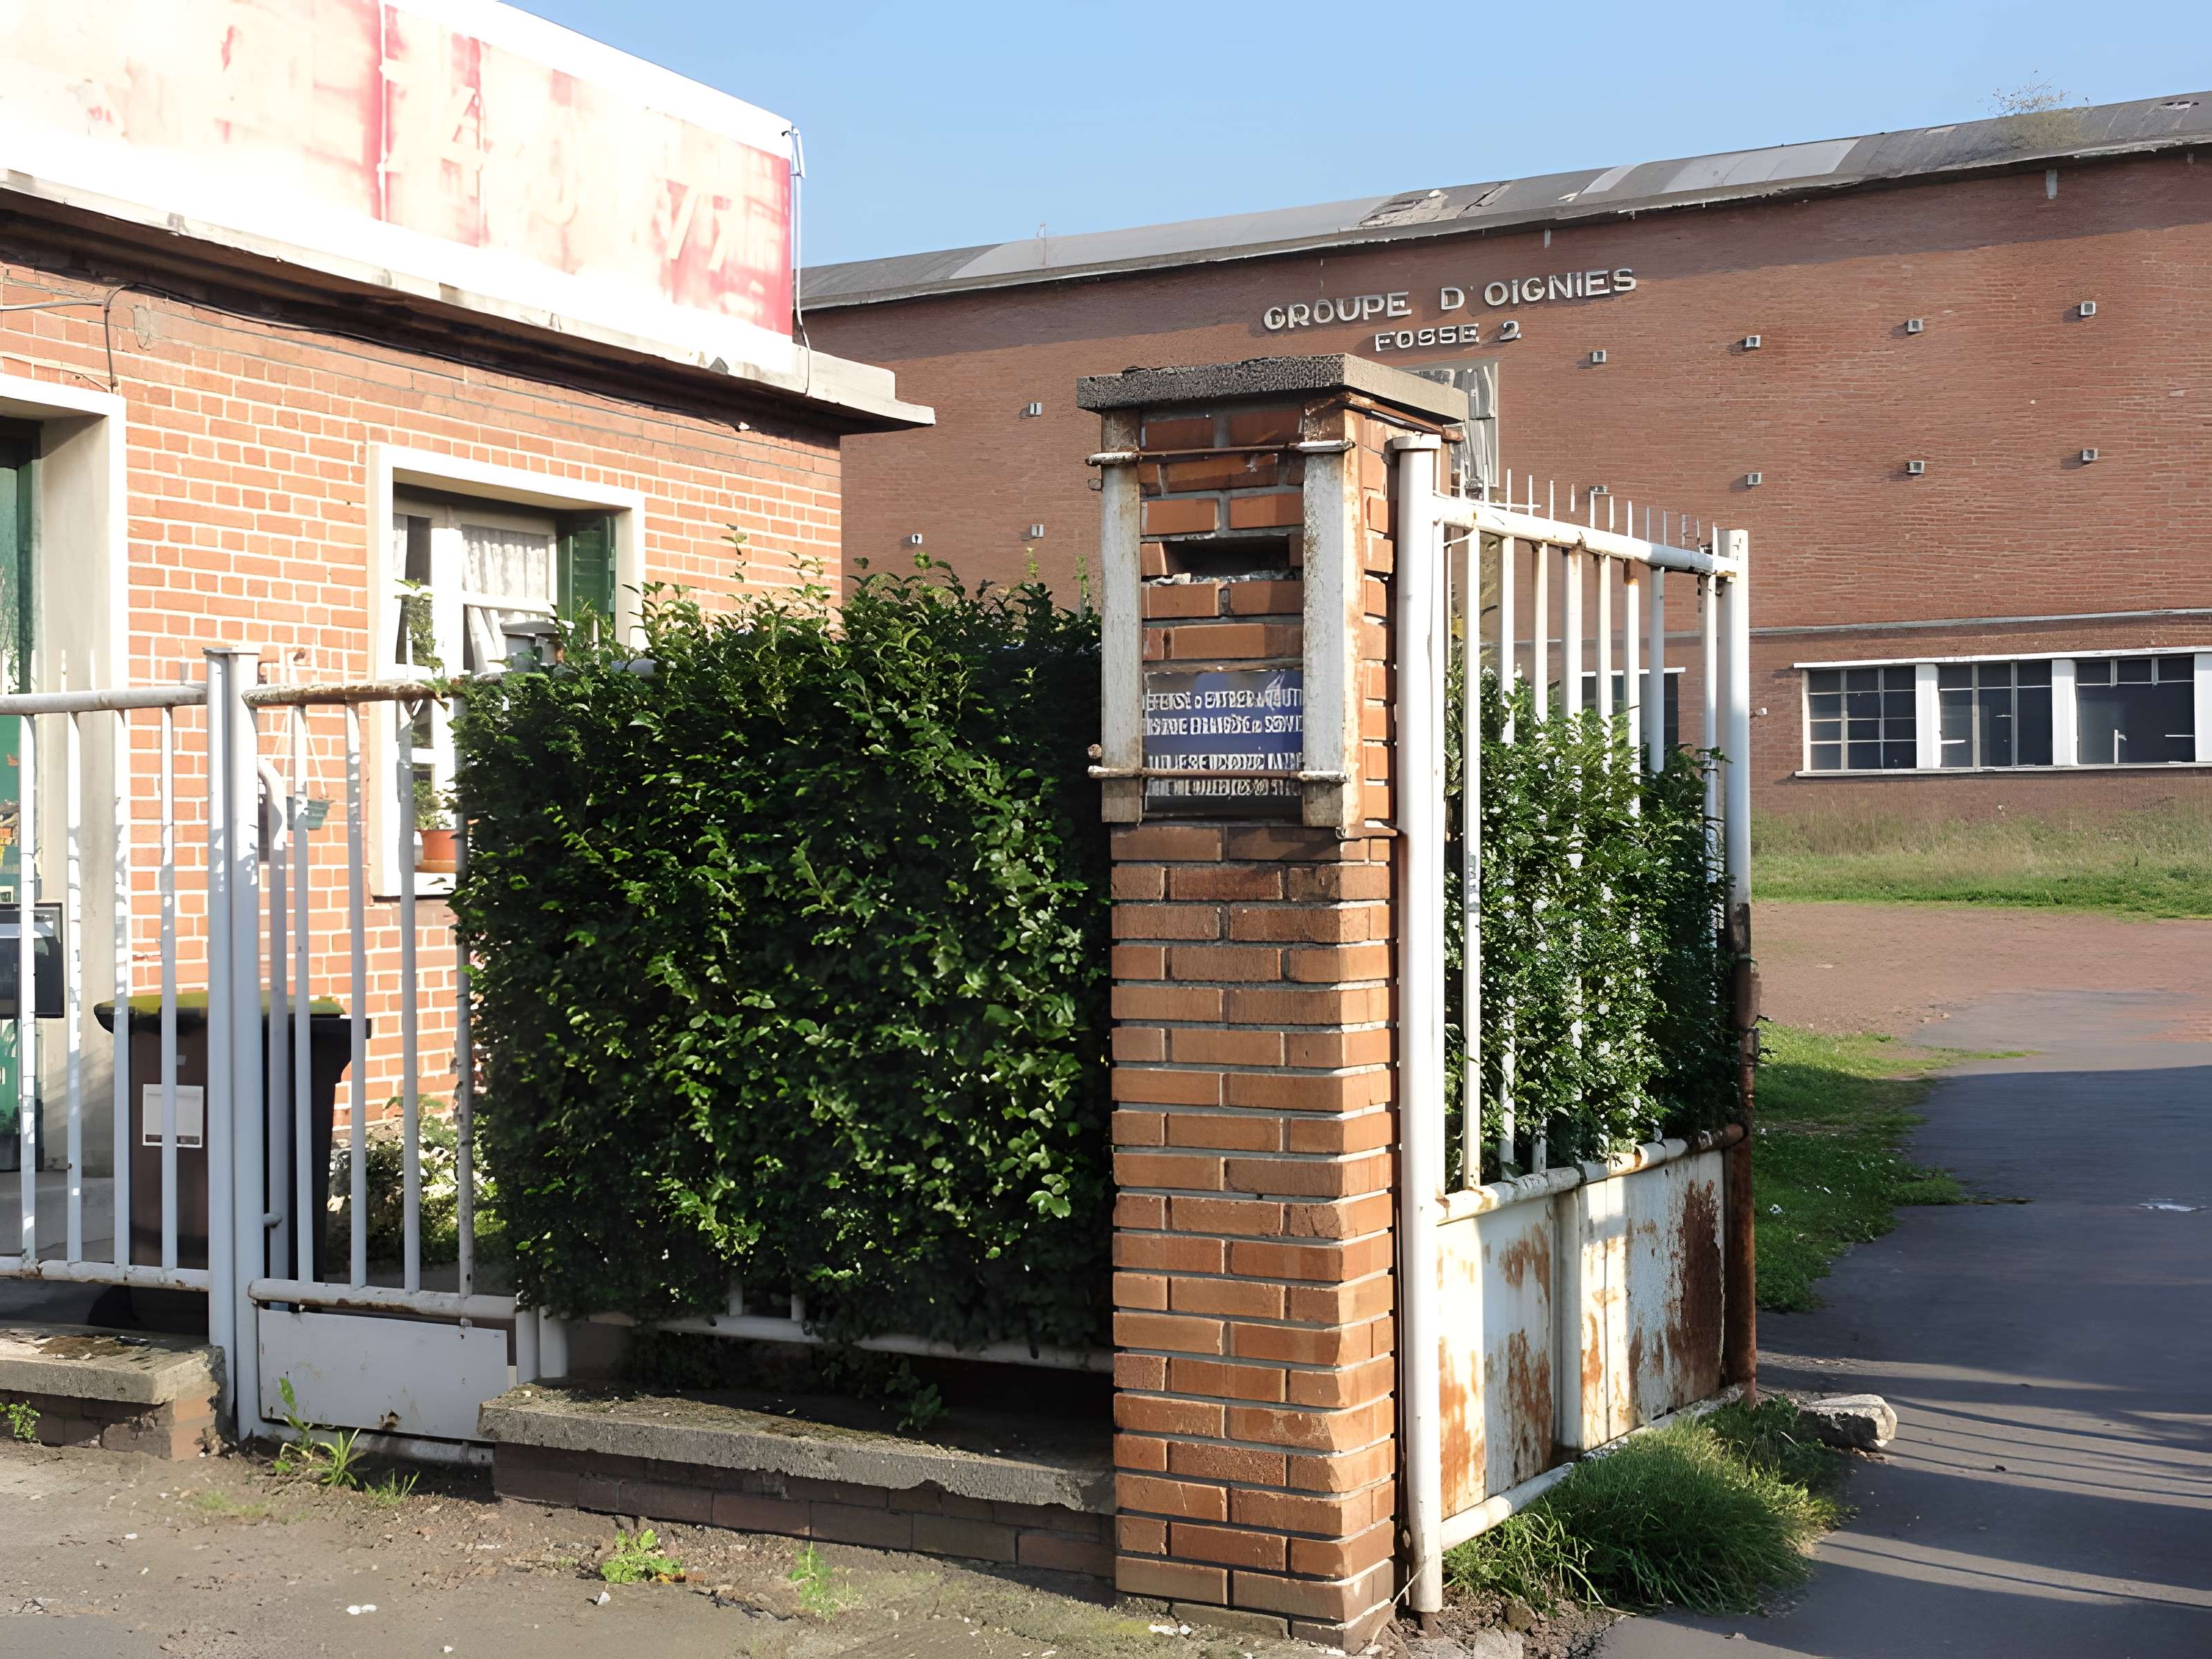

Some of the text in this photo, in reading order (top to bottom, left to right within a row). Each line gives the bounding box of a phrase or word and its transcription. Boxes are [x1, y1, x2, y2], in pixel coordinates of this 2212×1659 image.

[1264, 291, 1412, 330] GROUPE
[1374, 320, 1521, 352] FOSSE 2
